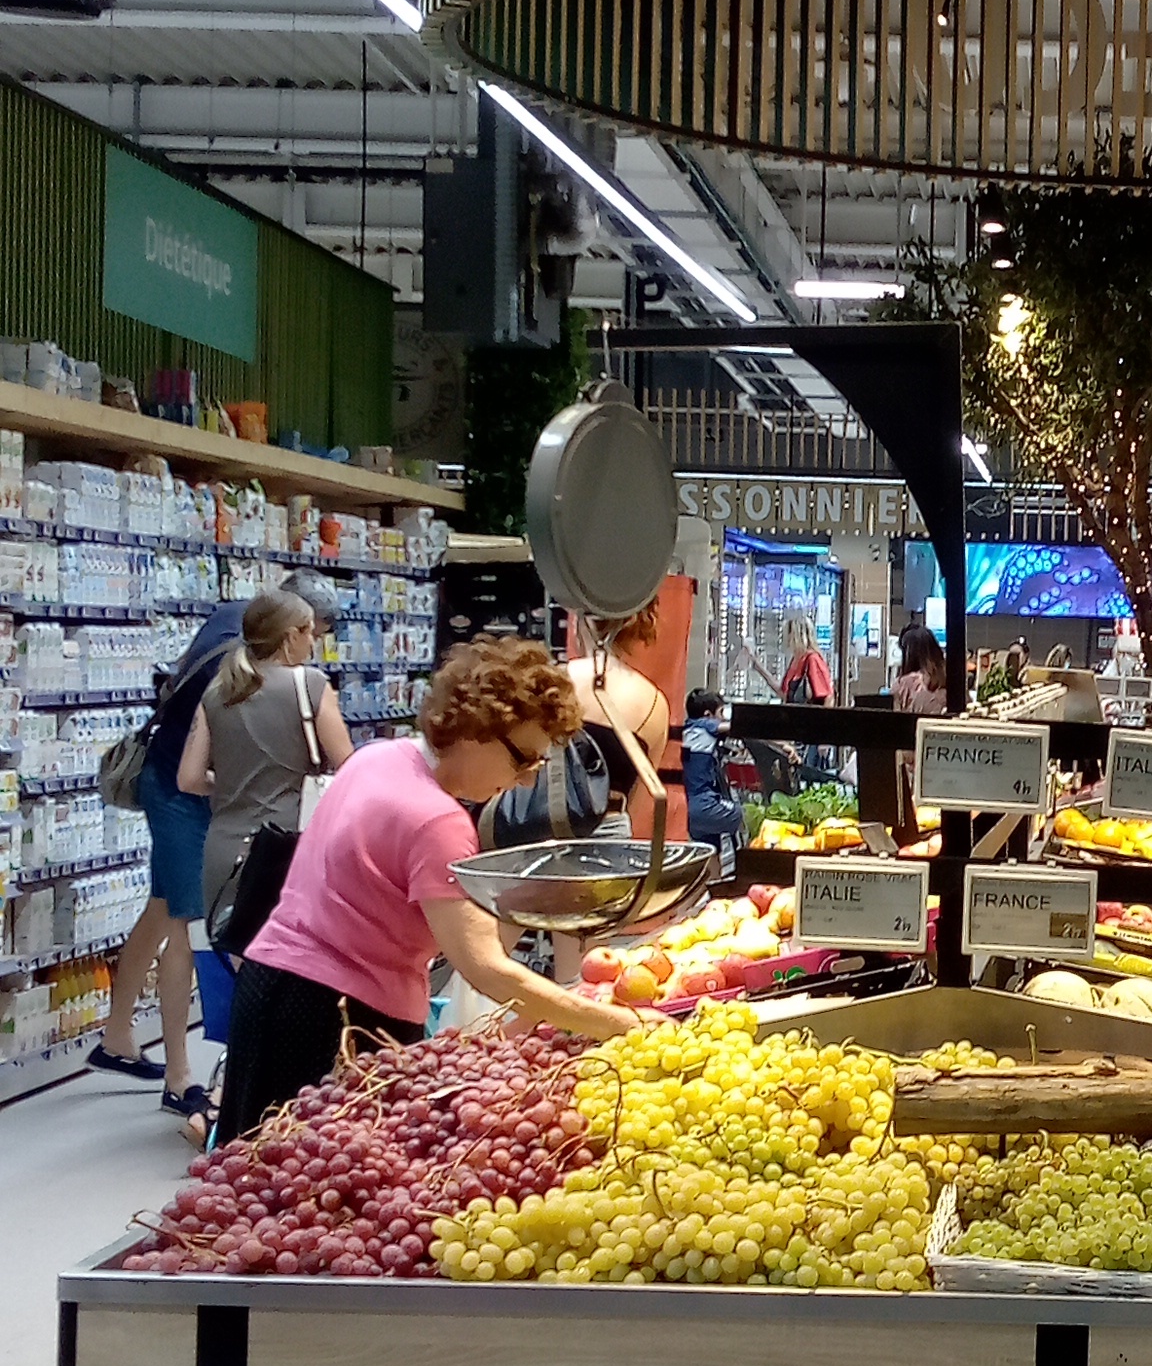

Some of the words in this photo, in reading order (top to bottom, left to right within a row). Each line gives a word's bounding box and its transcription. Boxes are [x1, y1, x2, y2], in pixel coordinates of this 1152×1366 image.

[145, 215, 232, 299] Diététique
[925, 745, 1004, 766] FRANCE
[804, 884, 862, 903] ITALIE
[973, 892, 1052, 910] FRANCE
